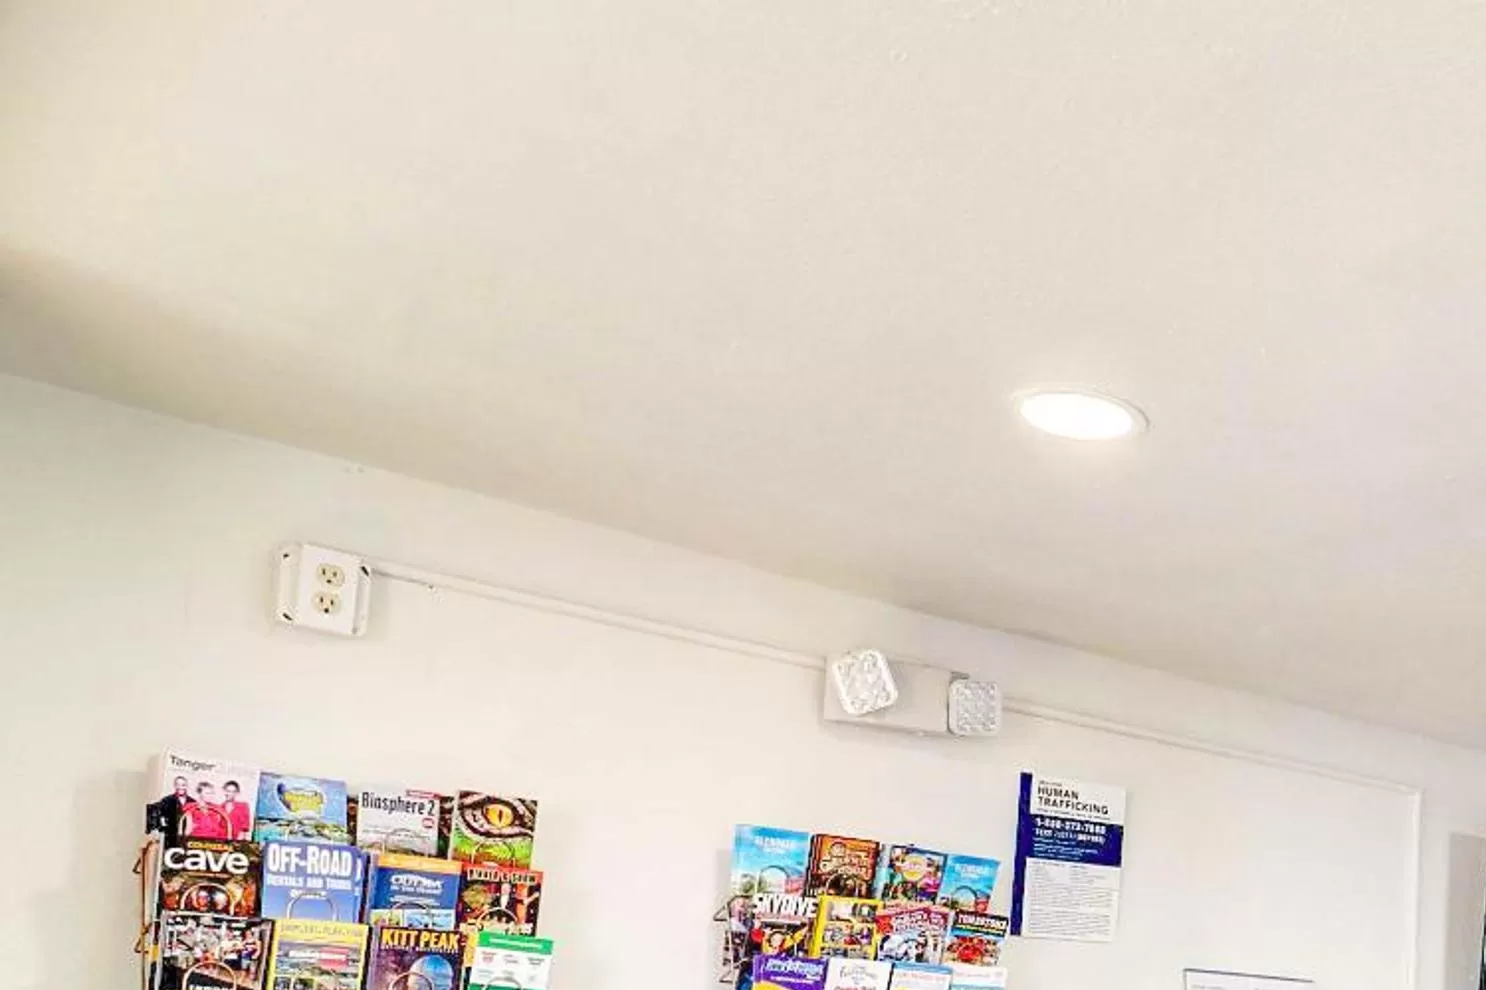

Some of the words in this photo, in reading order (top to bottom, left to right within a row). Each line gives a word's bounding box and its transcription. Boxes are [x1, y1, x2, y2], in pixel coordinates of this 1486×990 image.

[170, 754, 216, 772] Tanger
[1037, 786, 1079, 799] HUMAN
[361, 792, 428, 815] Biosphere
[427, 799, 436, 816] 2
[1037, 796, 1109, 815] TRAFFICKING
[164, 847, 249, 875] cave
[267, 842, 353, 877] OFF-ROAD
[382, 928, 420, 947] KITT
[420, 931, 460, 949] PEAK
